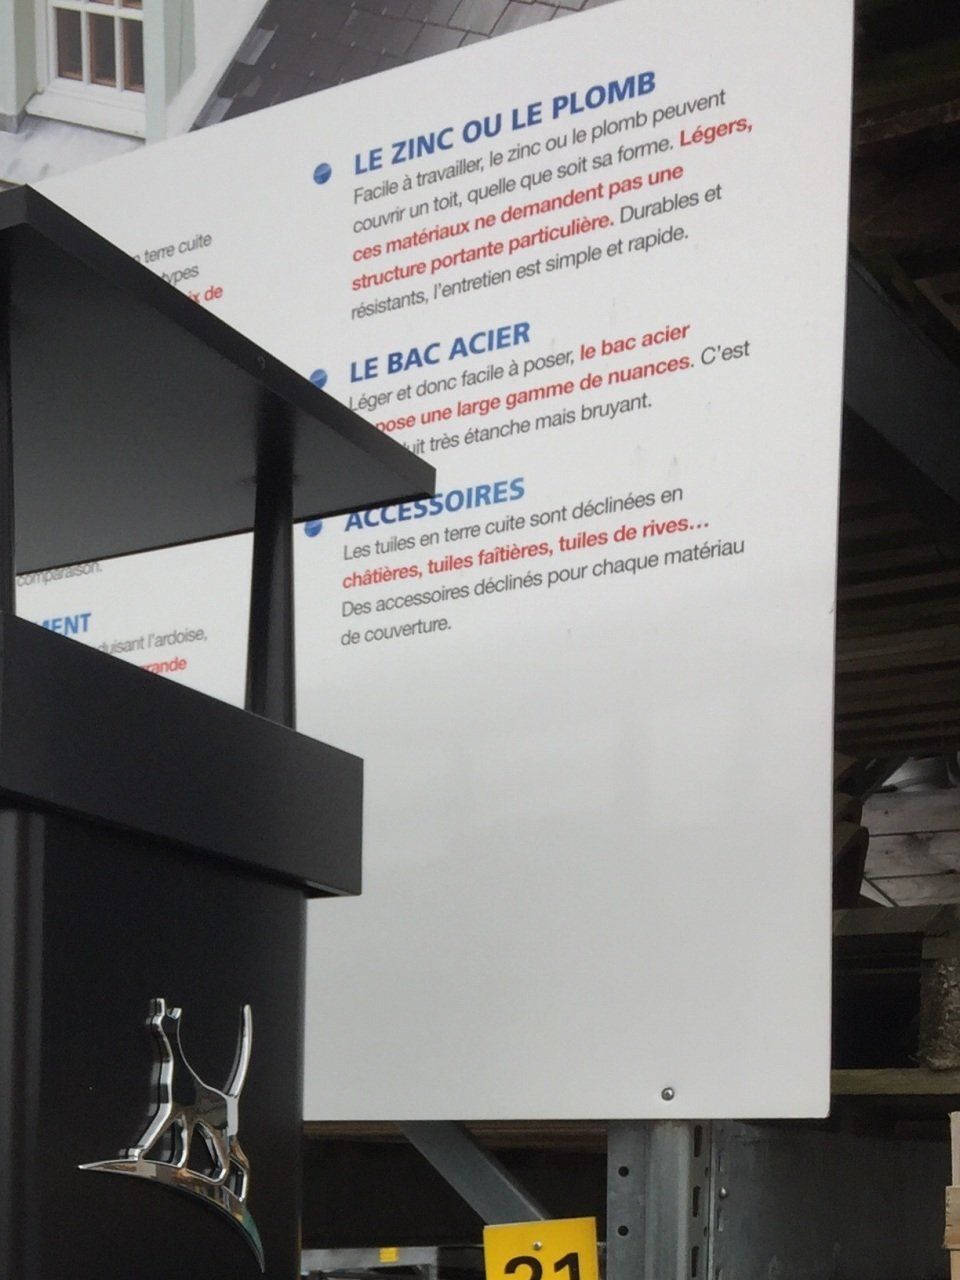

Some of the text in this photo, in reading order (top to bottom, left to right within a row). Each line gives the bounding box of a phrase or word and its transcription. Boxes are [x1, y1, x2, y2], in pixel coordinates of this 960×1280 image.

[354, 90, 725, 204] Facile à travailler, le zinc ou le plomb peuvent
[355, 71, 655, 175] LE ZINC OU LE PLOMB
[353, 119, 752, 233] couvrir un toit, quelle que soit sa forme. Légers,
[353, 166, 683, 261] ces matériaux ne demandent pas une
[178, 234, 212, 254] cuite
[352, 184, 722, 291] structure portante particulière. Durables et
[352, 226, 688, 319] résistants, l'entretien est simple et rapide.
[204, 285, 224, 301] de
[348, 325, 690, 412] Léger et donc facile à poser, le bac acier
[350, 322, 530, 383] LE BAC ACIER
[375, 341, 750, 432] pose une large gamme de nuances. C'est
[430, 434, 459, 451] très
[464, 420, 530, 444] étanche
[536, 409, 575, 429] mais
[581, 393, 651, 420] bruyant.
[344, 478, 525, 532] ACCESSOIRES
[344, 488, 683, 560] Les tuiles en terre cuite sont déclinées en
[342, 540, 744, 617] Des accessoires déclinés pour chaque matériau
[428, 555, 473, 574] tuiles
[478, 543, 553, 565] faîtières,
[559, 532, 608, 551] tuiles
[613, 525, 637, 542] de
[341, 619, 451, 645] de couverture.
